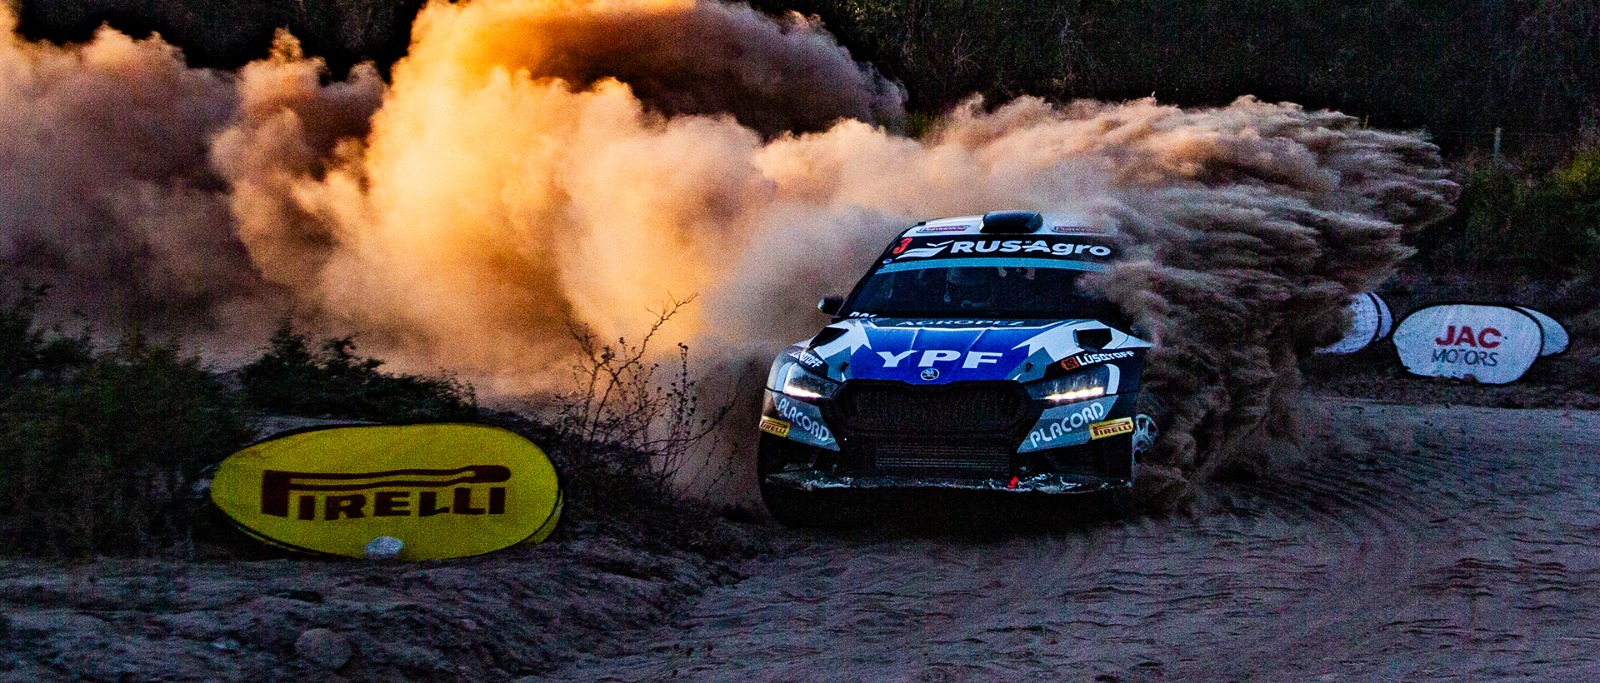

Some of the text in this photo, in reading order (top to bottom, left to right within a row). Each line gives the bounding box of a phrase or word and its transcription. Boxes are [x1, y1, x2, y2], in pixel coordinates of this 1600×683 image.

[893, 237, 911, 254] 3
[1435, 325, 1501, 348] JAC
[877, 350, 1003, 369] YPF
[1431, 349, 1498, 366] MOTORS
[761, 421, 790, 436] PIRELLI
[777, 398, 829, 441] PLACORD
[1029, 402, 1104, 448] PLACORD
[1093, 421, 1132, 436] PIRELLI
[261, 465, 511, 521] PIRELLI
